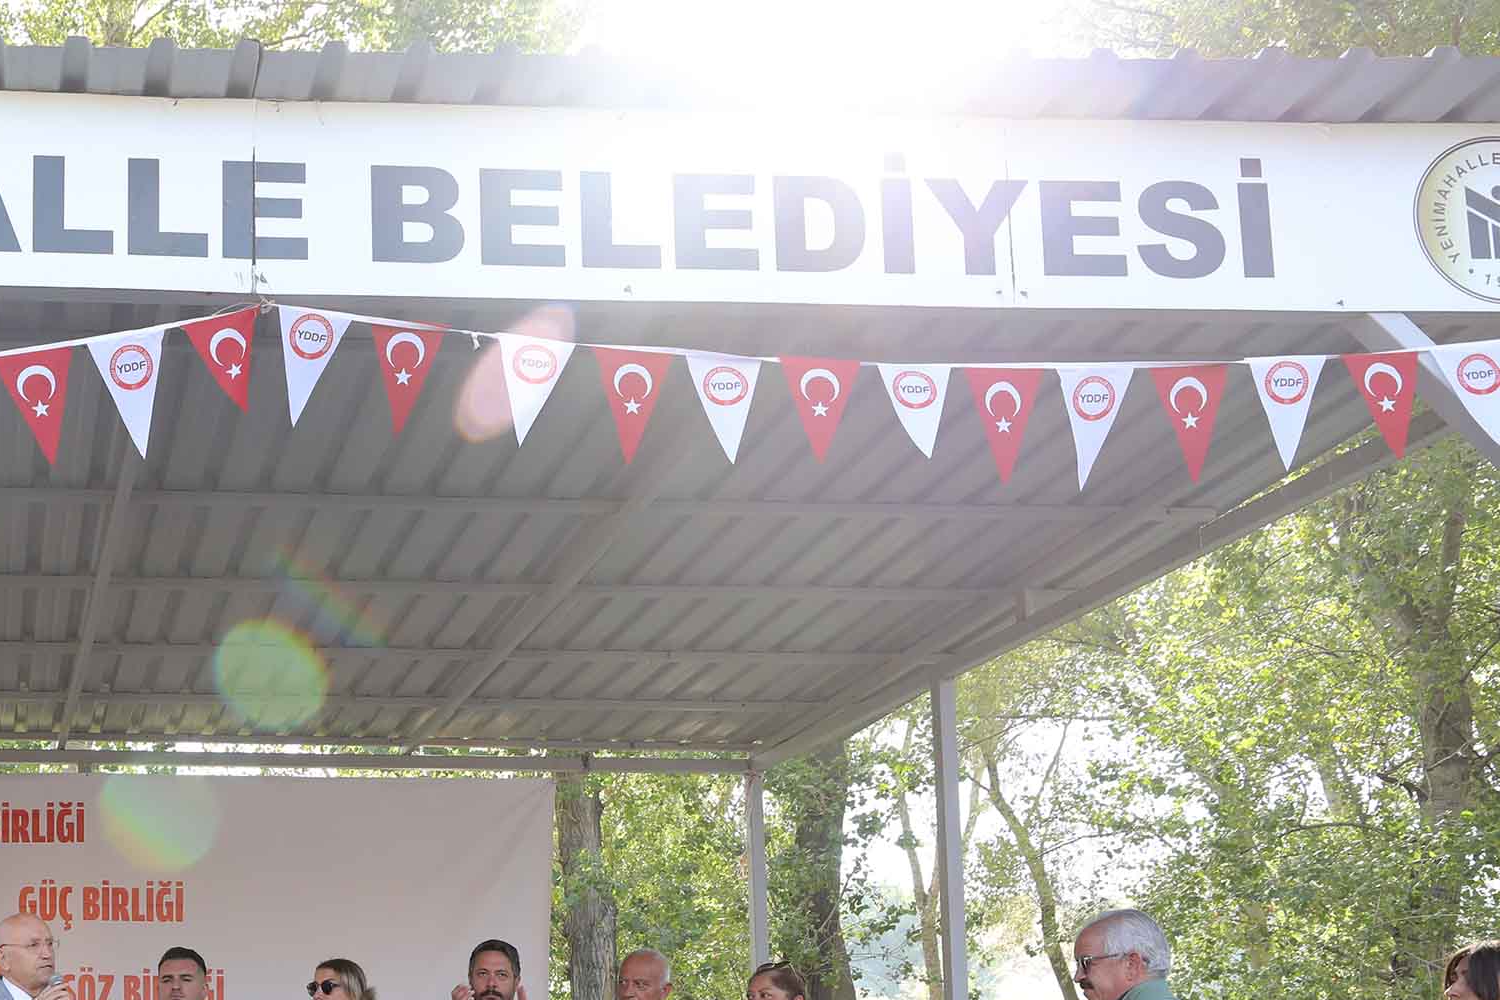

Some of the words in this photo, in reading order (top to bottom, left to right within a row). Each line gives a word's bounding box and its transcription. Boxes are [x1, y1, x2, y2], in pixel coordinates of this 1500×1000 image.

[370, 153, 1276, 279] BELEDİYESİ
[297, 331, 327, 343] YDDF
[117, 360, 146, 373] YDDF
[1464, 369, 1494, 380] YDDF
[710, 380, 740, 390] YDDF
[1272, 377, 1302, 388] YDDF
[900, 384, 930, 394] YDDF
[1080, 392, 1109, 403] YDDF
[18, 879, 74, 931] GÜÇ
[82, 880, 185, 923] BİRLİĞİ
